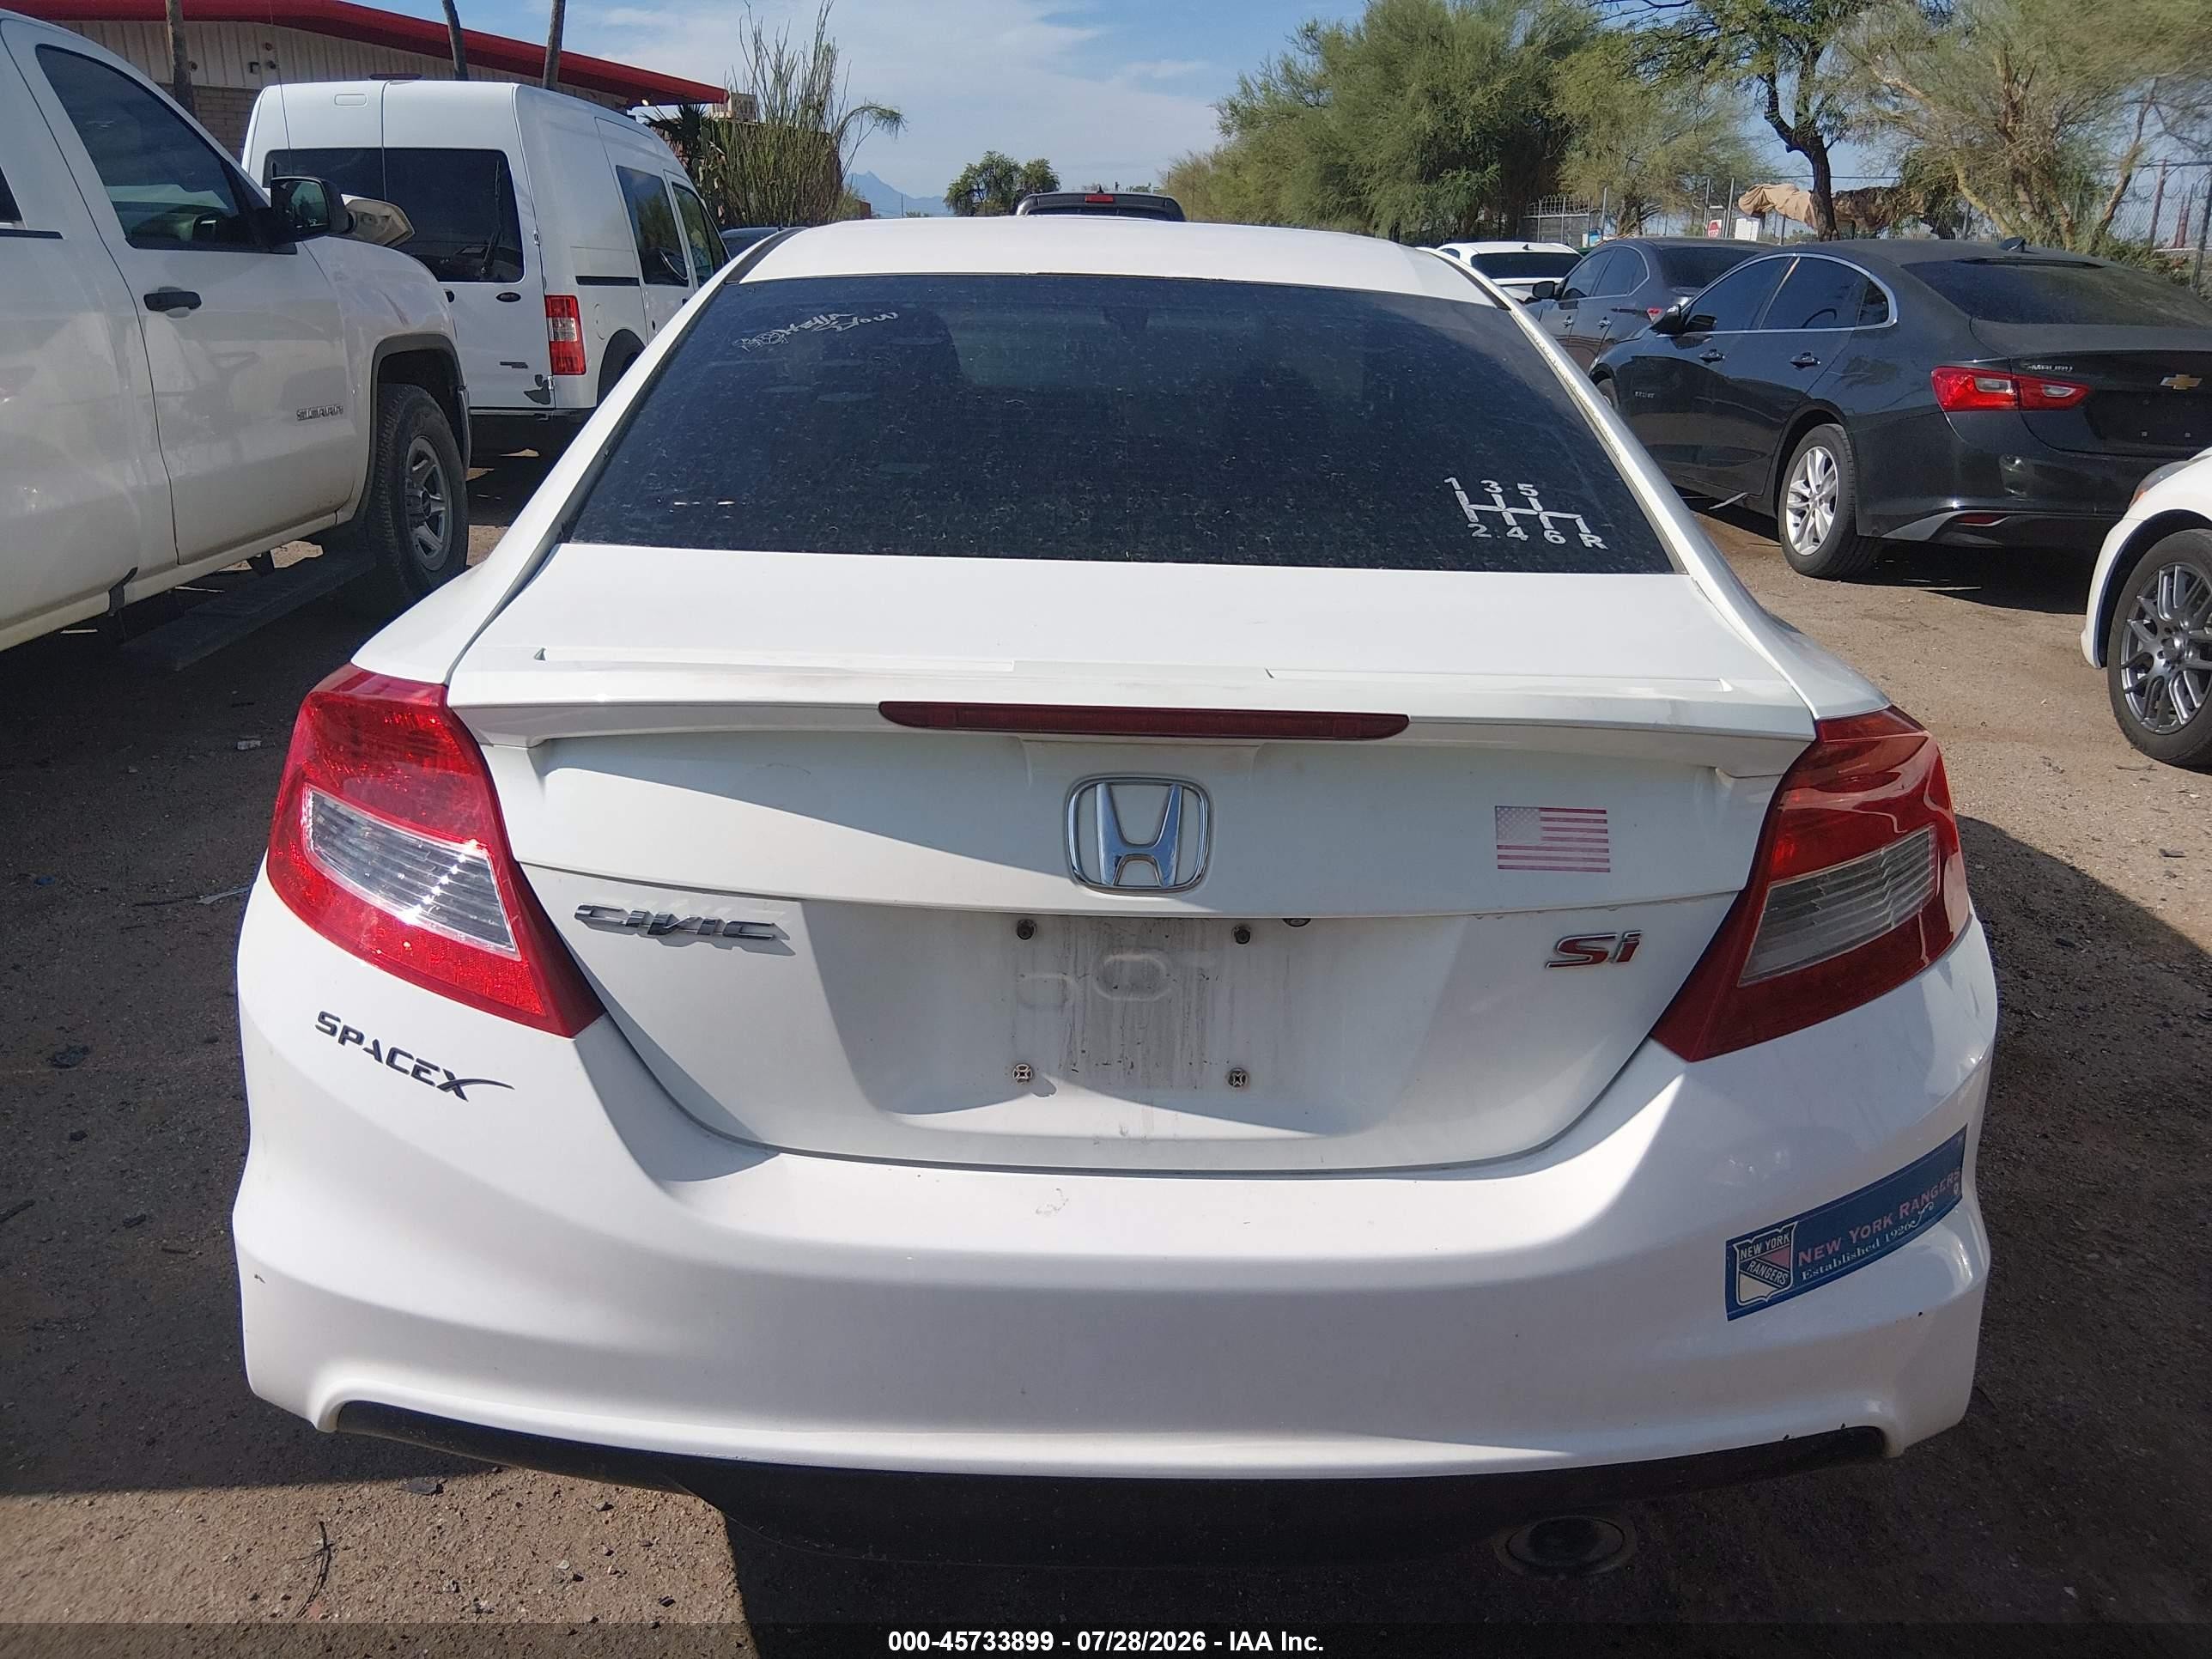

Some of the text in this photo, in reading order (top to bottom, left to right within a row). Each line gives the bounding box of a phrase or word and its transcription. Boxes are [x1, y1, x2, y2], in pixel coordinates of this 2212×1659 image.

[1443, 477, 1540, 497] 1 3 5
[1468, 523, 1609, 550] 2 4 6 R
[574, 902, 780, 941] CIVIC
[1546, 931, 1642, 968] Si
[314, 1011, 515, 1103] SPACEX
[1740, 1232, 1791, 1261] NEW YORK
[1797, 1237, 1842, 1267] NEW
[1848, 1212, 1894, 1243] YORK
[1747, 1260, 1789, 1285] RANGERS
[1802, 1237, 1881, 1280] Established
